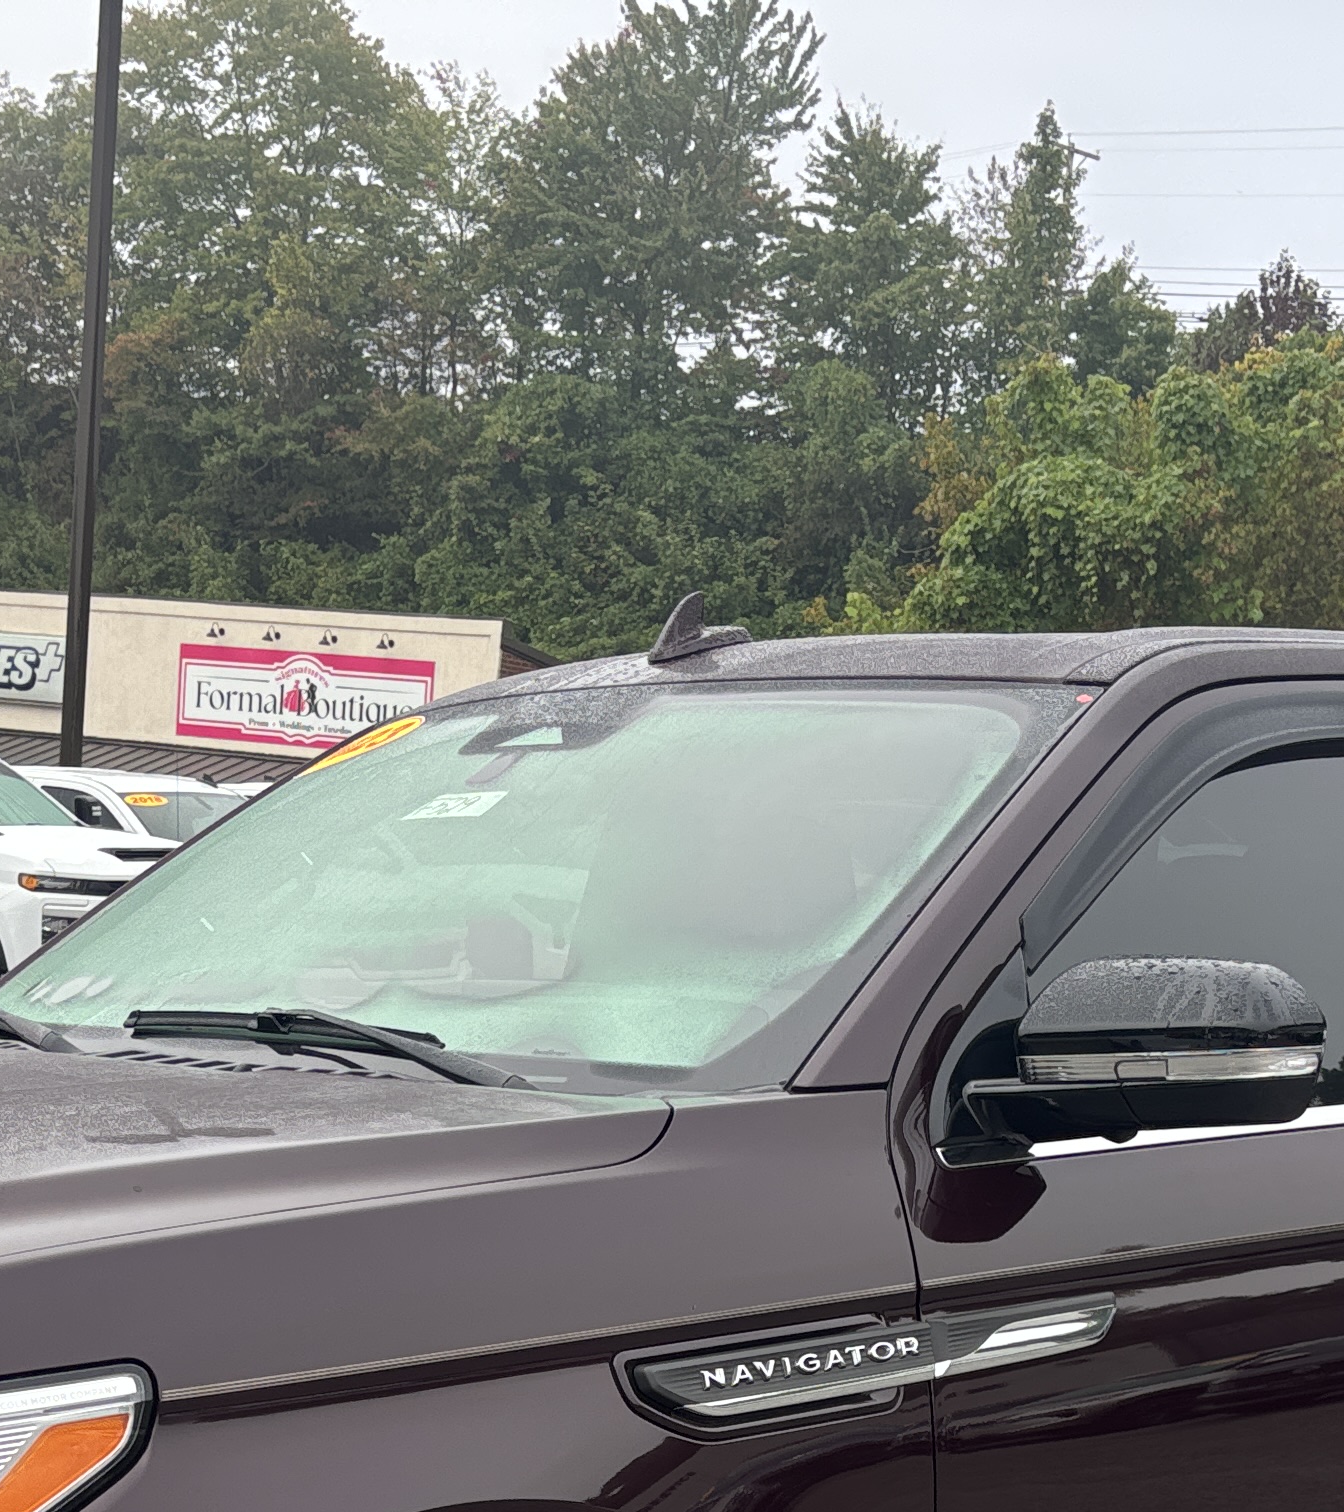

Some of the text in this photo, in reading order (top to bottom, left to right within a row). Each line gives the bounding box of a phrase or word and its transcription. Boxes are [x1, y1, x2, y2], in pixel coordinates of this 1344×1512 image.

[195, 680, 411, 723] Formal Boutique
[700, 1336, 920, 1391] NAVIGATOR
[31, 1394, 67, 1407] MOTOR
